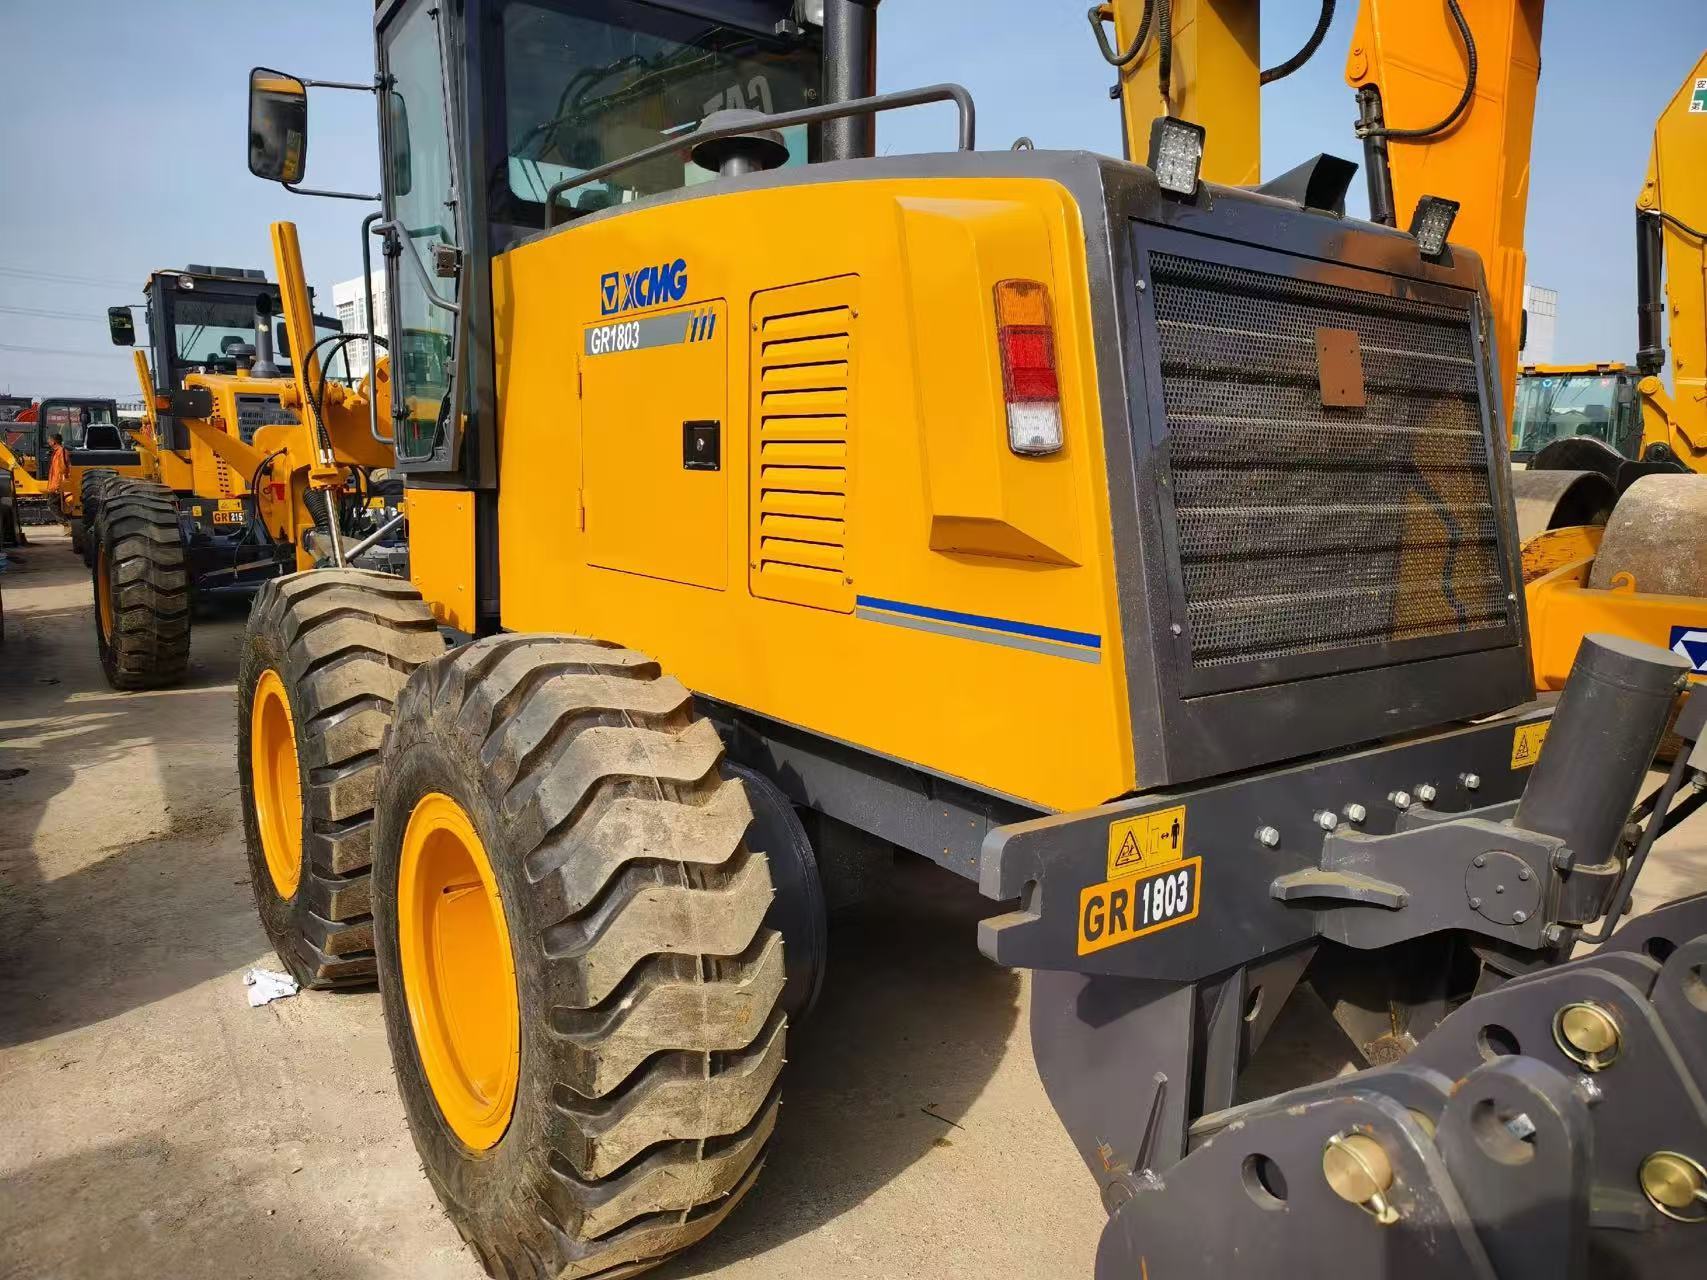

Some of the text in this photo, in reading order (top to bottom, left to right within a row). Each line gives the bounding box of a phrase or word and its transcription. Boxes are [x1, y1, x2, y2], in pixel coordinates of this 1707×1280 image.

[620, 258, 688, 312] XCMG
[591, 321, 640, 354] GR1803
[214, 512, 245, 522] GR 215
[1084, 870, 1189, 942] GR 1803
